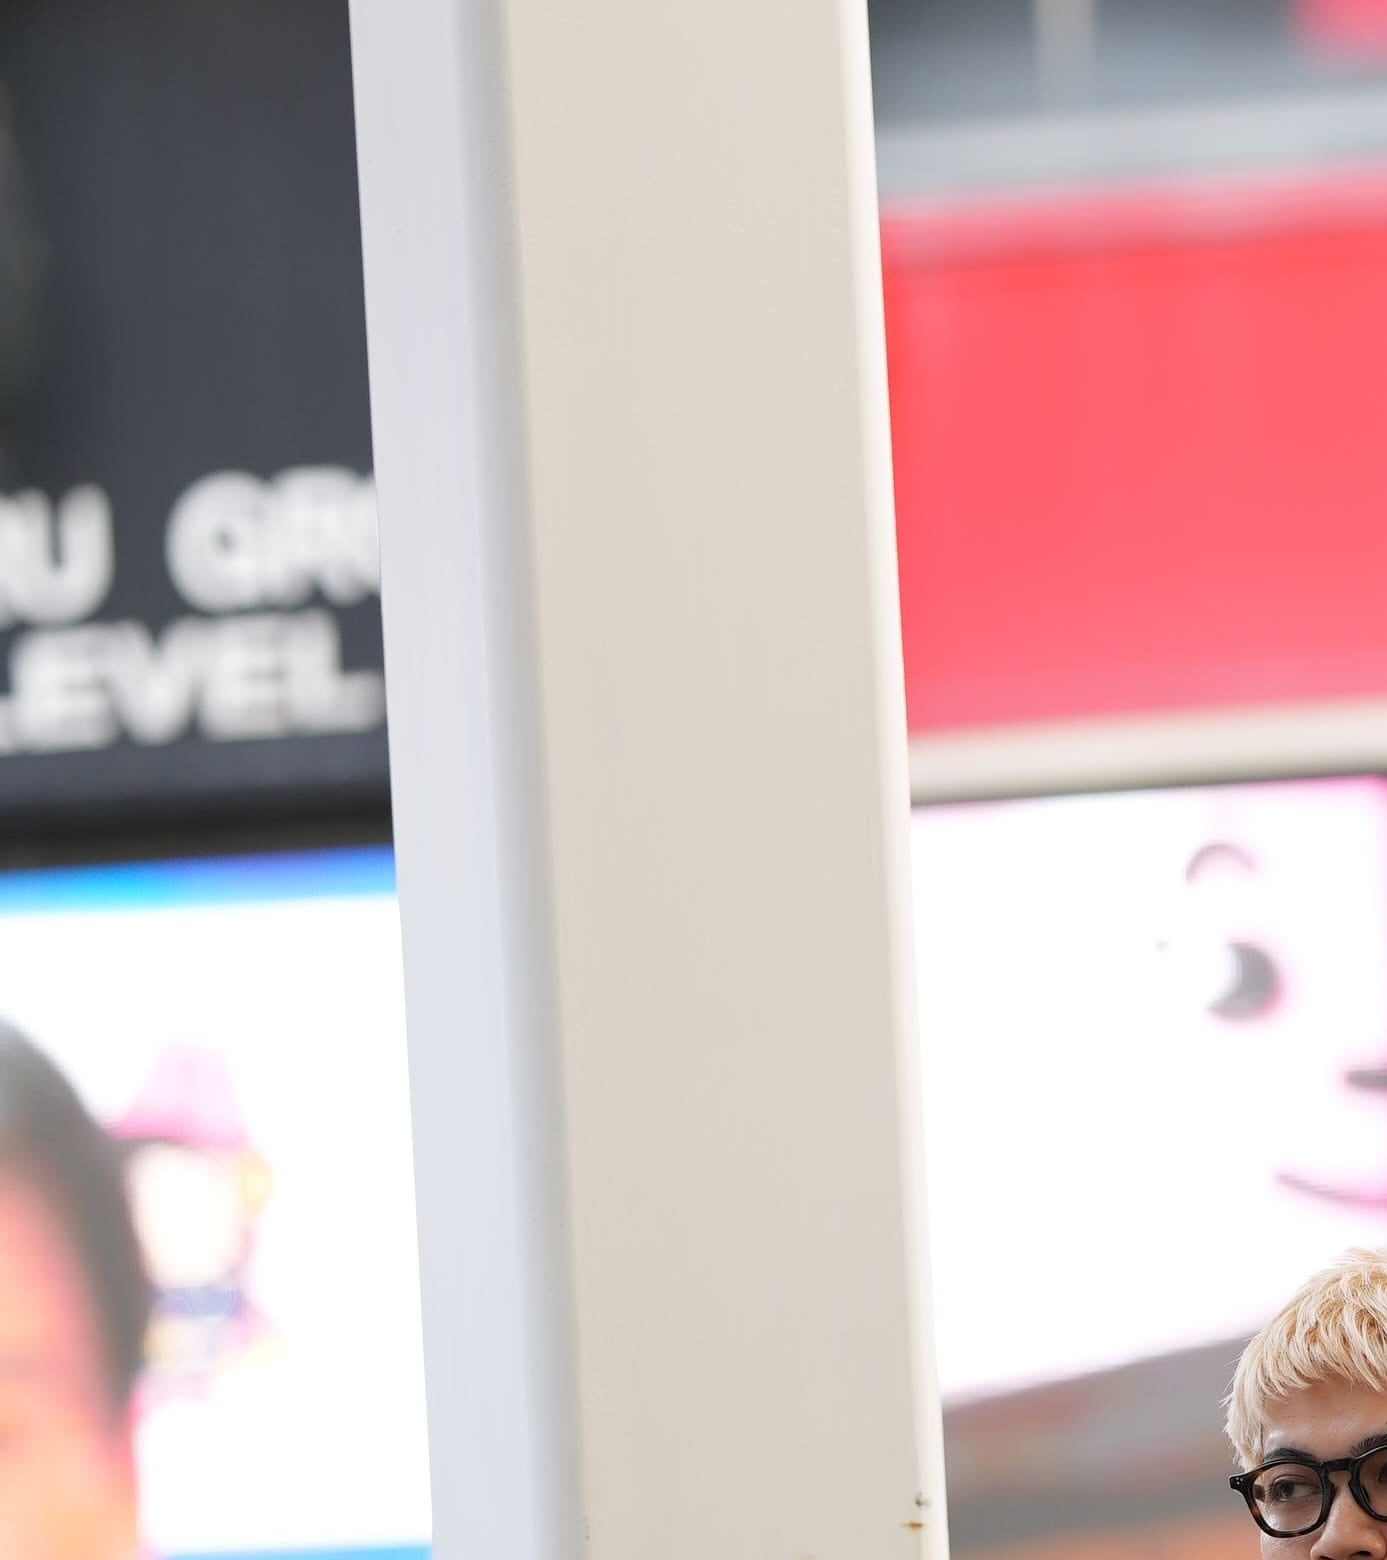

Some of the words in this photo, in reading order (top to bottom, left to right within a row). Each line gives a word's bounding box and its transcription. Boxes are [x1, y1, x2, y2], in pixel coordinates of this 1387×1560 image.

[0, 483, 114, 628] U
[165, 465, 381, 614] GR
[0, 608, 386, 752] EVEL
